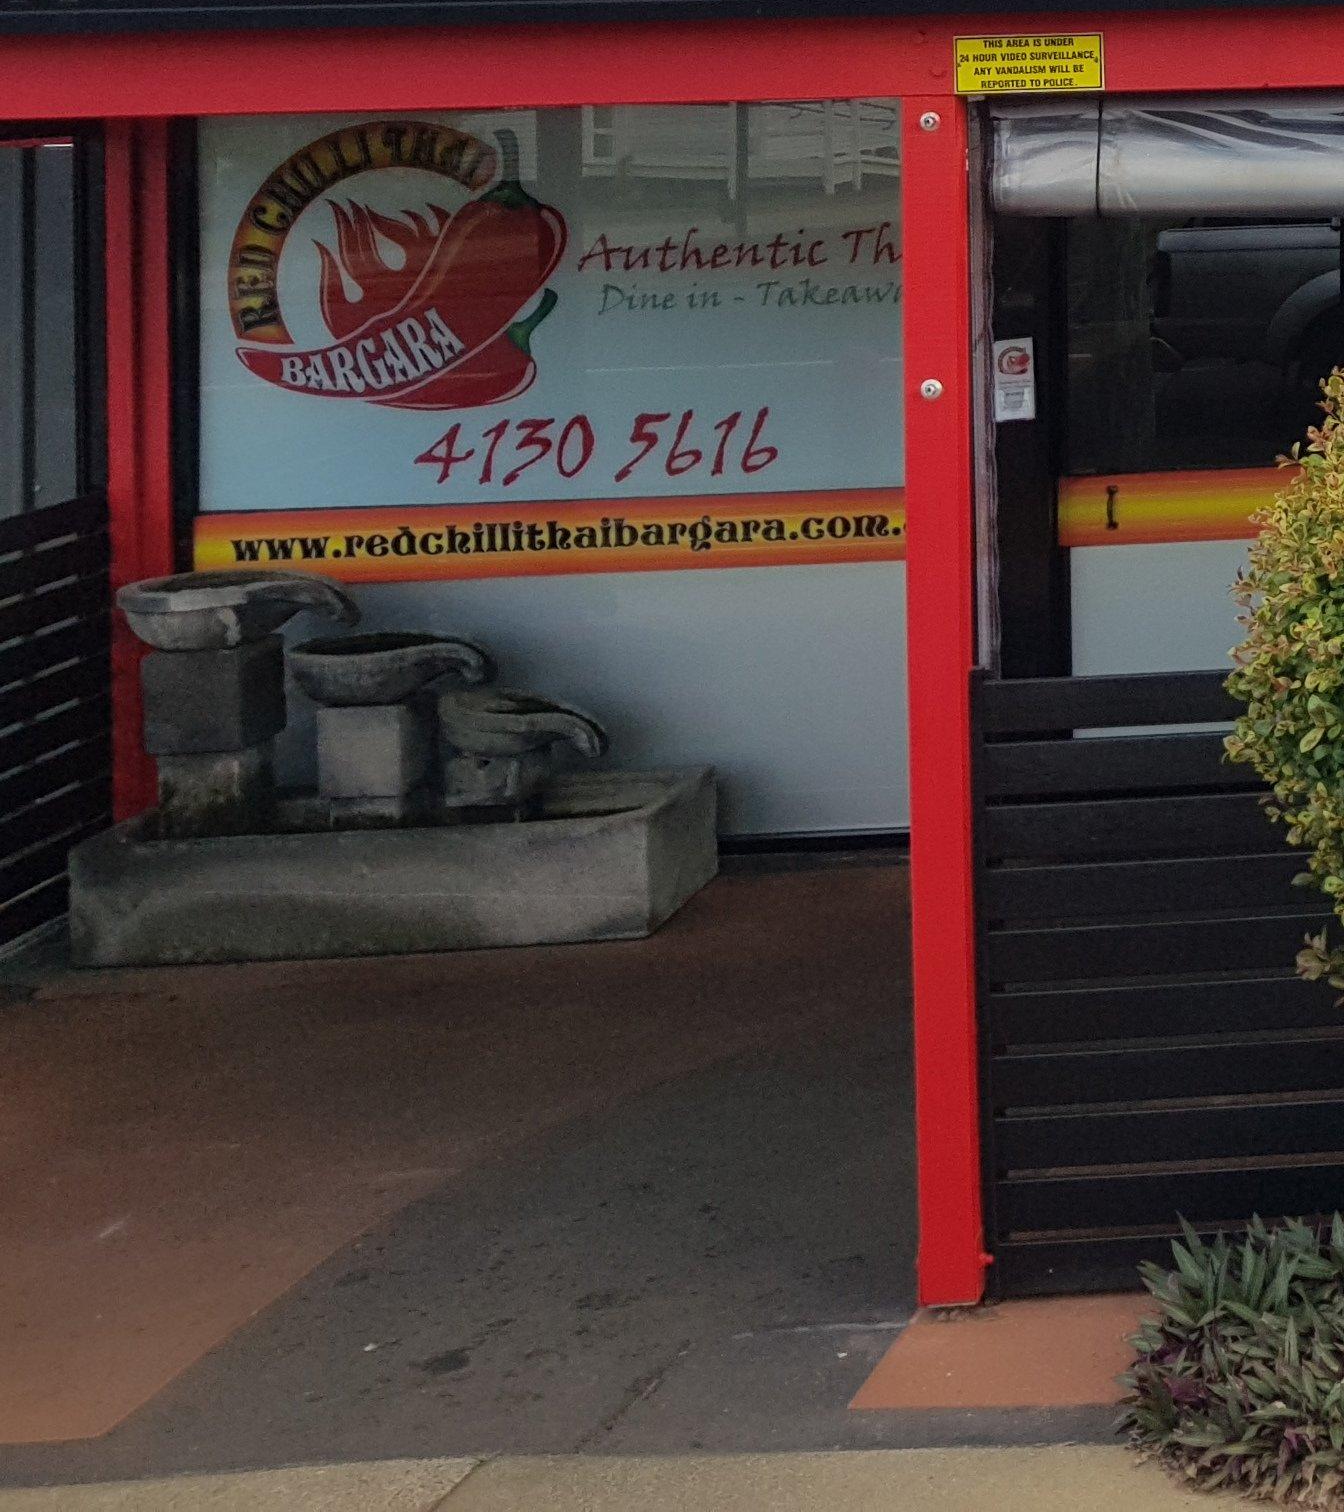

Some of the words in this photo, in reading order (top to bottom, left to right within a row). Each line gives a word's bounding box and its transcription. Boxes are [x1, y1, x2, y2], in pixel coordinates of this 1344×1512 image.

[959, 54, 969, 63] 24
[972, 53, 997, 62] HOUR
[1000, 52, 1027, 61] VIDEO
[1029, 50, 1095, 61] SURVEILLANCE
[983, 39, 1003, 48] THIS
[1006, 39, 1030, 48] AREA
[1033, 39, 1042, 47] IS
[1044, 38, 1074, 47] UNDER
[973, 66, 992, 76] ANY
[995, 65, 1046, 76] VANDALISM
[1049, 65, 1070, 74] WILL
[1073, 64, 1085, 73] BE
[981, 79, 1026, 89] REPORTED
[1029, 79, 1041, 88] TO
[577, 228, 827, 272] Authentic
[237, 244, 280, 332] RED
[598, 283, 678, 315] Dine
[688, 284, 721, 307] in
[281, 307, 466, 393] BARGARA
[414, 414, 595, 486] 4130
[615, 406, 778, 482] 5616
[231, 511, 906, 563] www.redchillithaibargara.com.
